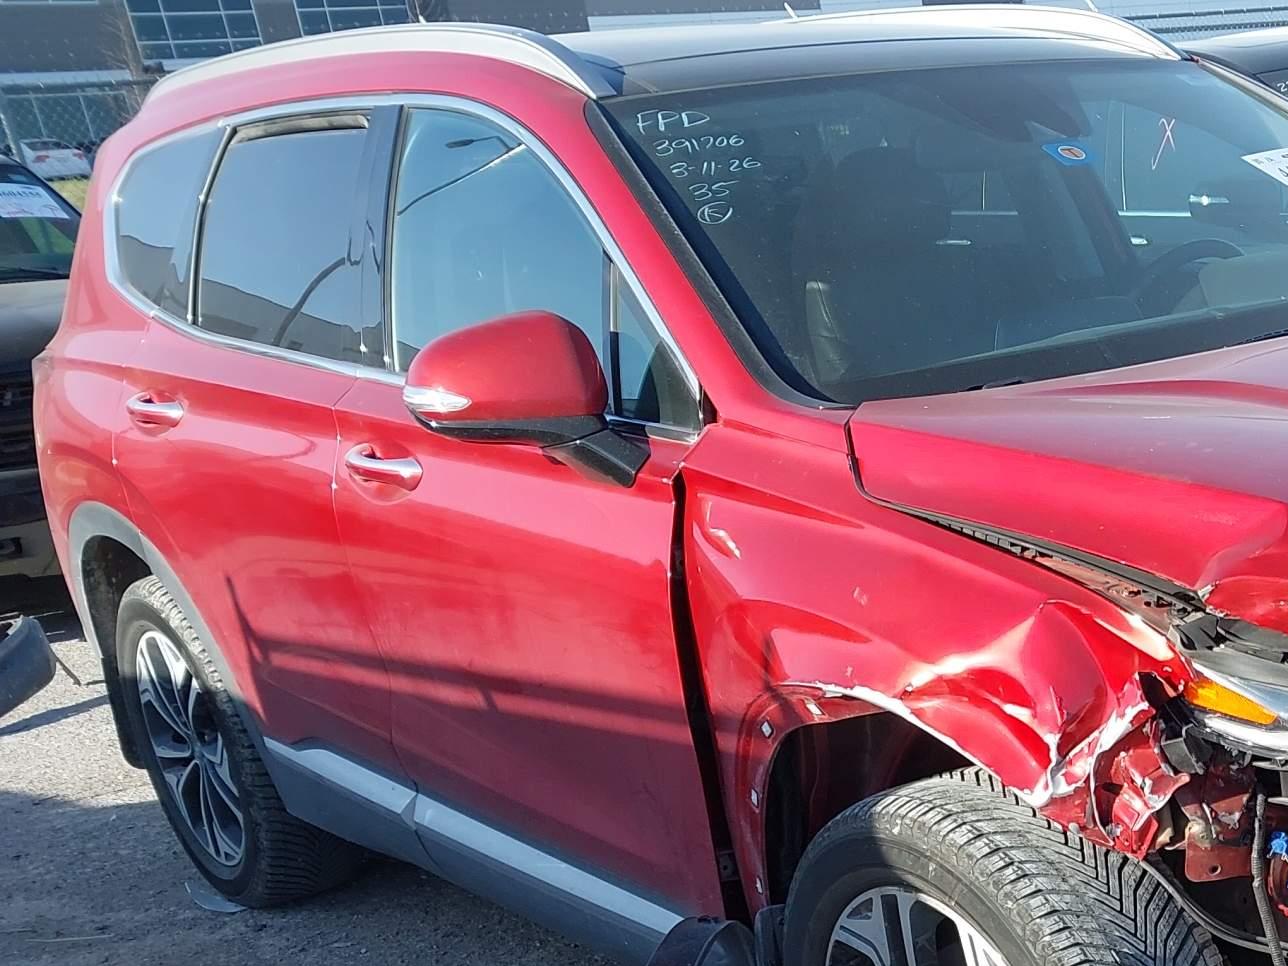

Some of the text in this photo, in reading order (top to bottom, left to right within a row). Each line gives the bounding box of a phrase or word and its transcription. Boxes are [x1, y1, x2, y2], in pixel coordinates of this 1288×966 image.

[636, 108, 711, 135] FPD
[652, 134, 745, 157] 391706
[688, 180, 740, 200] 35
